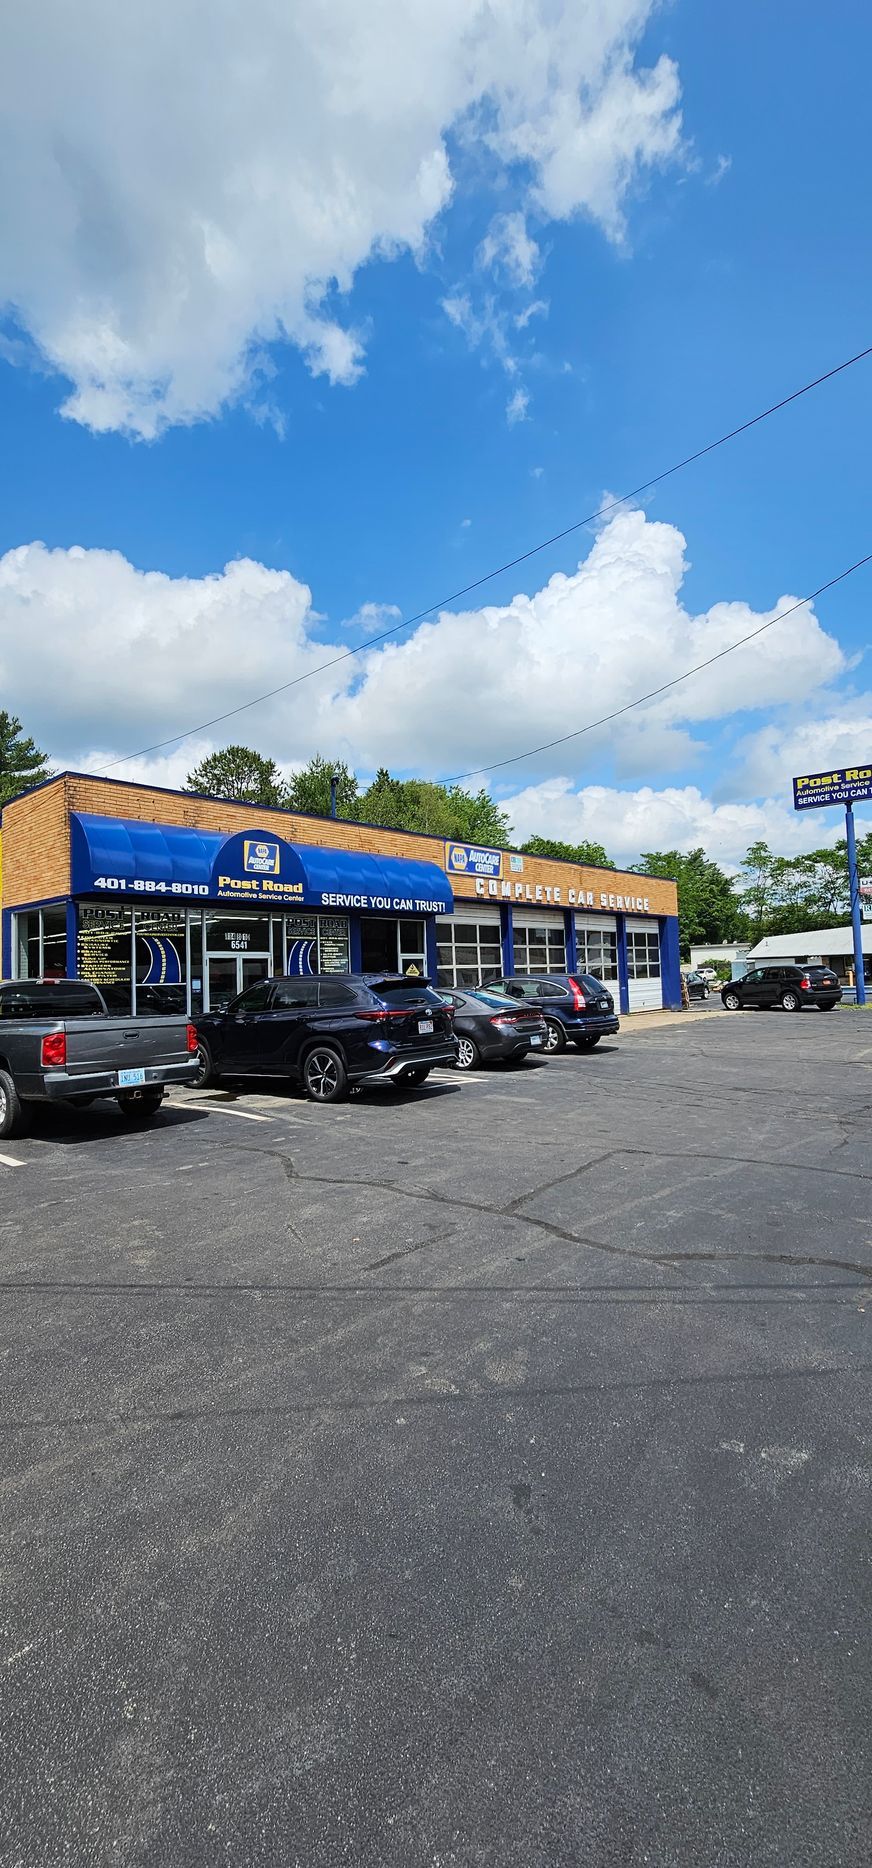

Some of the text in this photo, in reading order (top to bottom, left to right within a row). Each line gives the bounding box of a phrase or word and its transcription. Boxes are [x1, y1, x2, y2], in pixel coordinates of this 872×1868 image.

[796, 769, 872, 788] Post Ro
[796, 780, 870, 797] Automotive Service
[798, 794, 831, 805] SERVICE
[832, 791, 849, 800] YOU
[850, 788, 868, 797] CAN
[475, 863, 494, 874] CENTER
[94, 877, 209, 896] 401-884-8010
[218, 875, 304, 894] Post Road
[217, 889, 305, 902] Automotive Service Center
[321, 893, 446, 913] SERVICE YOU CAN TRUST!
[475, 878, 650, 912] COMPLETE CAR SERVICE
[82, 908, 182, 924] POST ROAD
[231, 940, 248, 949] 6541
